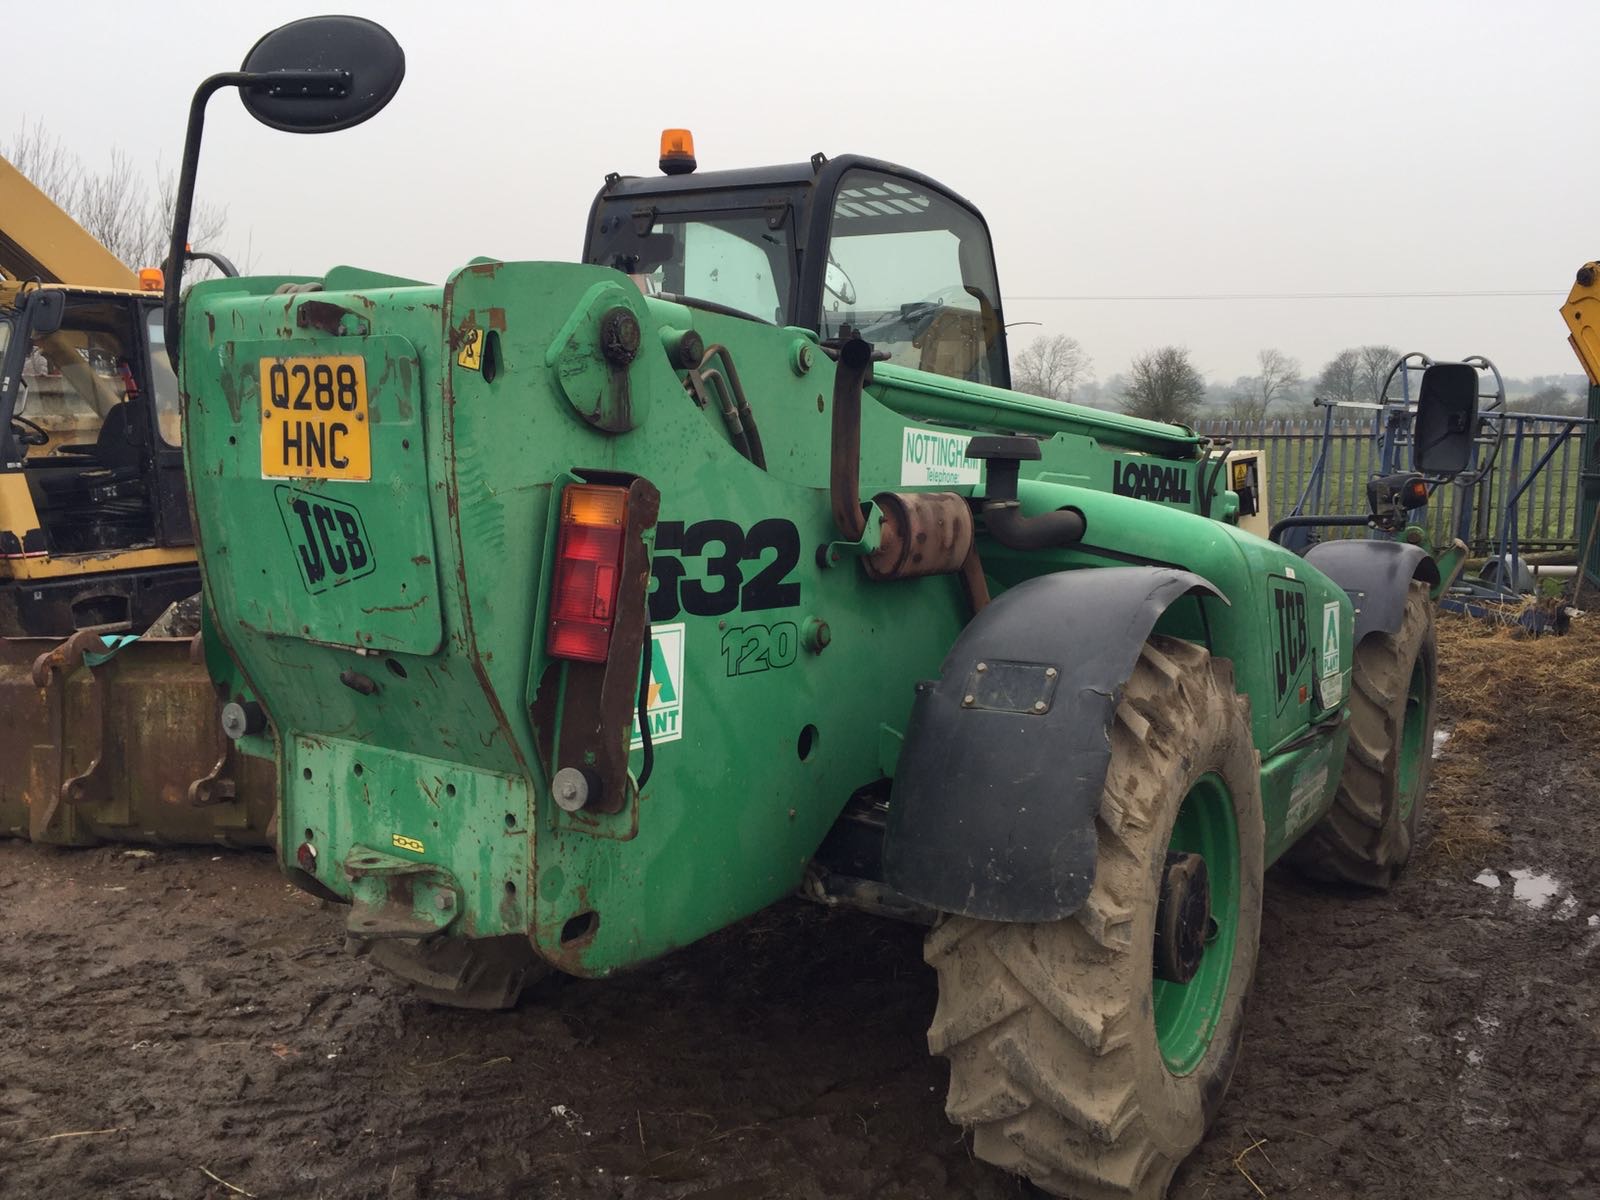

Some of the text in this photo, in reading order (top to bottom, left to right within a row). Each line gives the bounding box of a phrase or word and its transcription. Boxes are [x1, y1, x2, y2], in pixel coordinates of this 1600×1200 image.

[269, 363, 358, 411] Q288
[282, 420, 349, 469] HNC
[1112, 459, 1191, 504] LOADALL
[292, 499, 368, 584] JCB
[721, 621, 798, 677] 120
[1274, 587, 1307, 702] JCB
